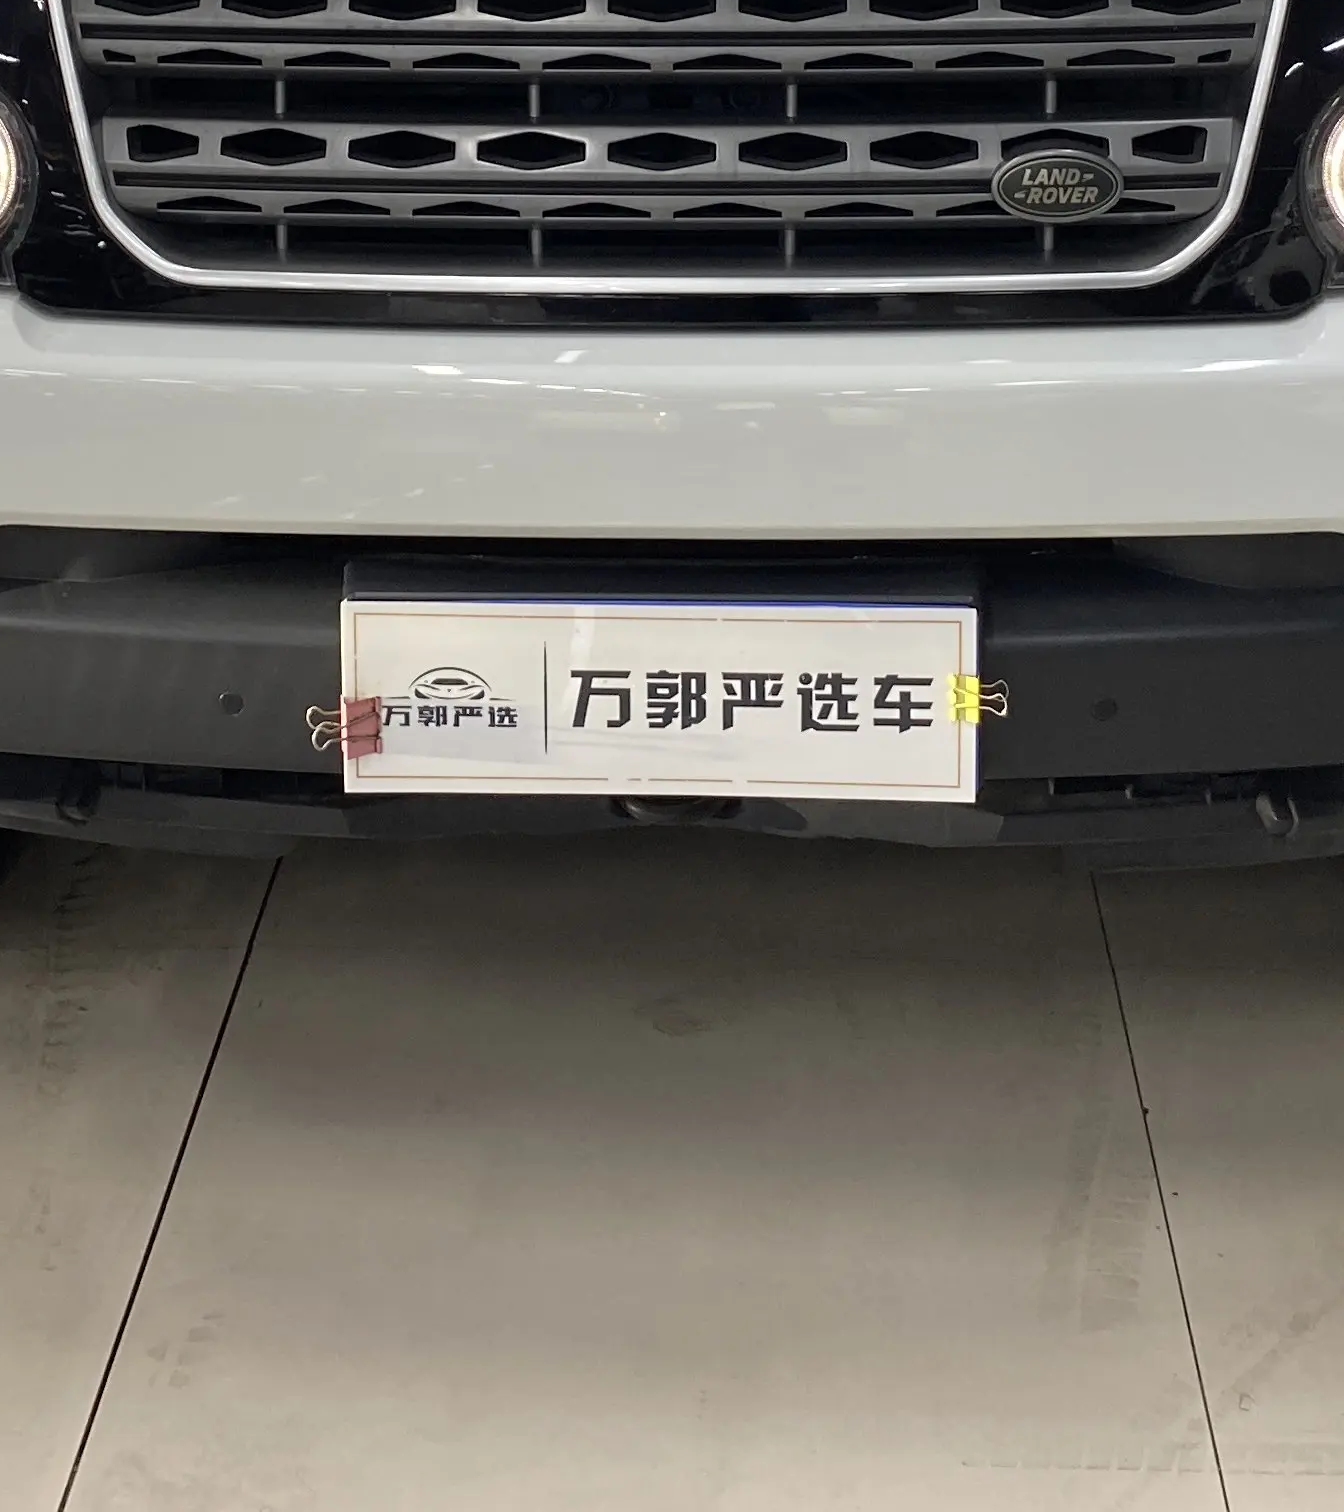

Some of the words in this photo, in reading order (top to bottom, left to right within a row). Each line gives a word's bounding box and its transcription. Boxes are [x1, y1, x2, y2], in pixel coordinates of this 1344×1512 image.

[381, 705, 518, 728] 万郭严选
[570, 669, 934, 734] 万郭严选车
